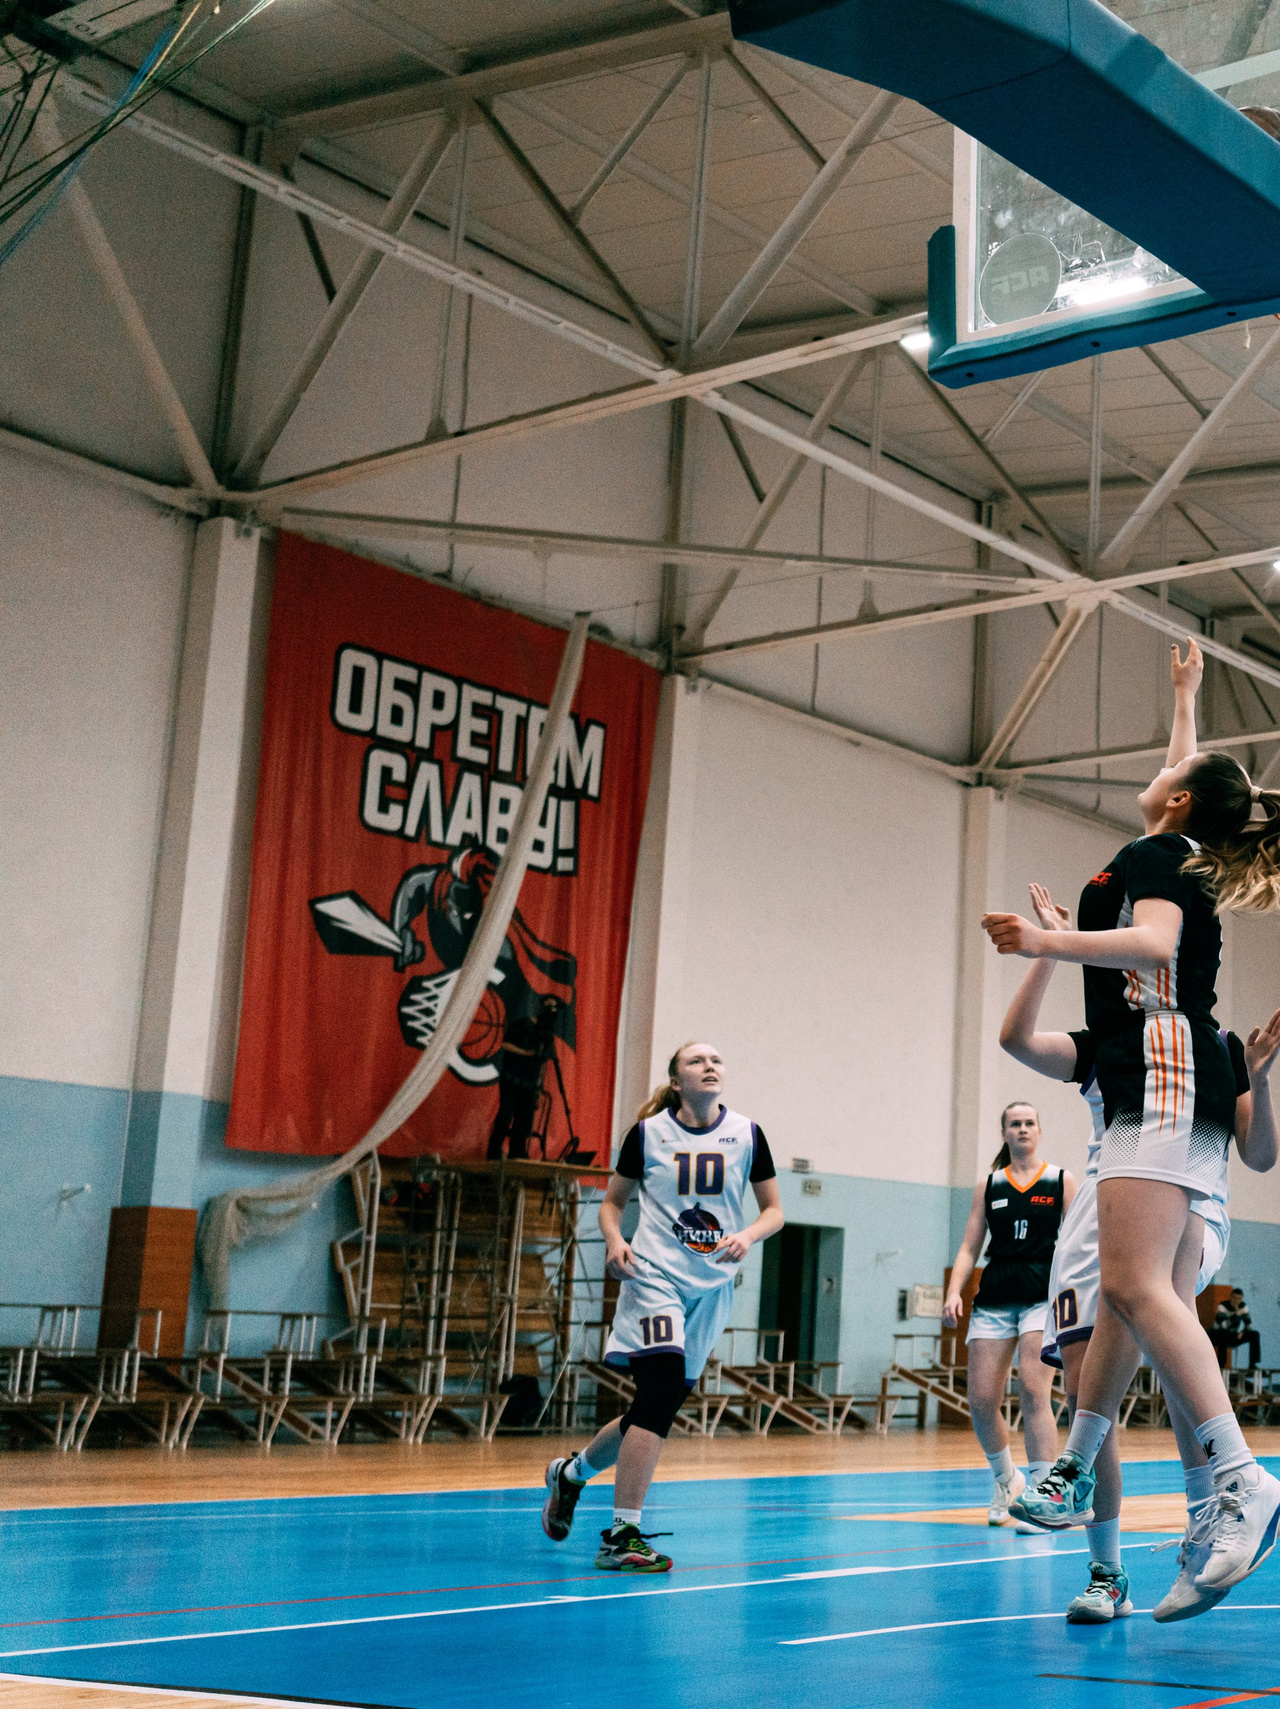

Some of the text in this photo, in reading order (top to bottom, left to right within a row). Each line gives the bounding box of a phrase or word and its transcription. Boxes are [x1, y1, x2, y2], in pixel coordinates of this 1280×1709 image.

[362, 747, 576, 873] СЛАВУ!
[673, 1151, 726, 1197] 10
[1013, 1219, 1029, 1240] 16
[639, 1314, 674, 1346] 10
